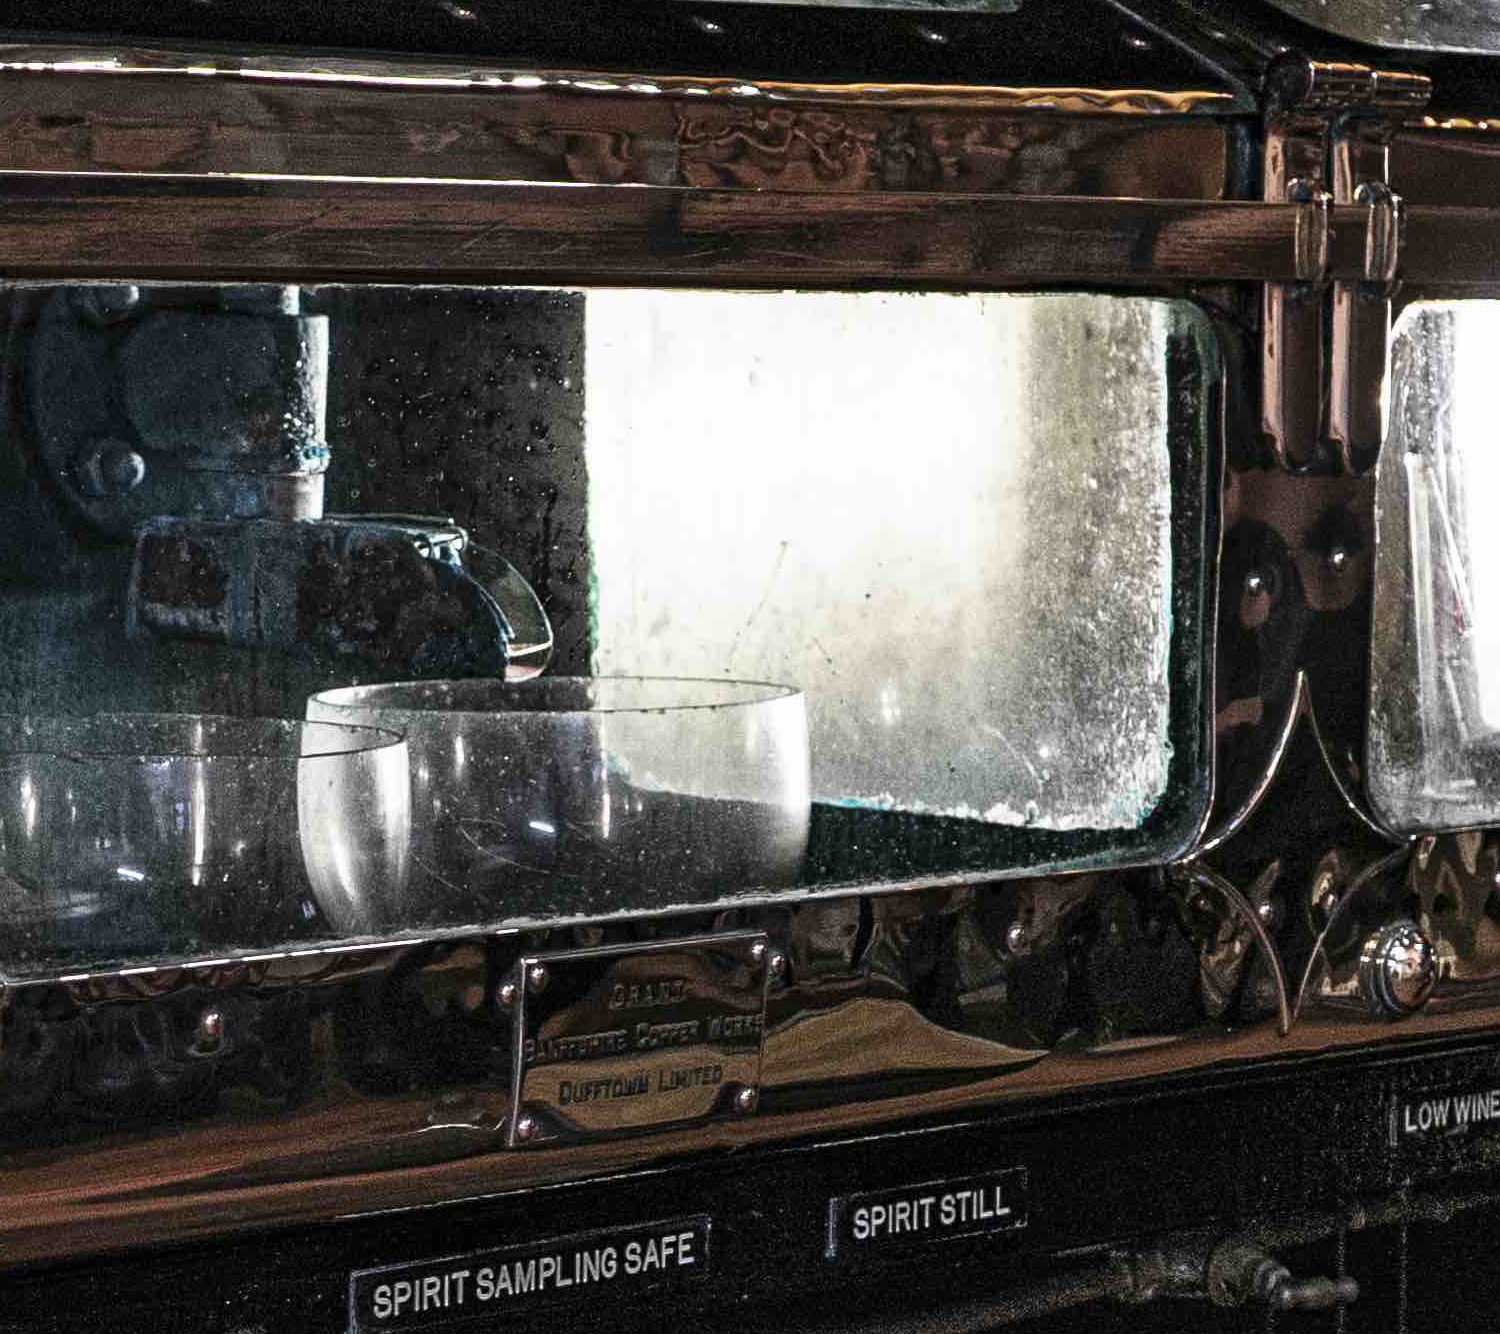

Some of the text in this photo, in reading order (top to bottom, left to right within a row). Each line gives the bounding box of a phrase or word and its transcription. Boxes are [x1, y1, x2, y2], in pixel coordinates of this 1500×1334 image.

[1404, 1096, 1451, 1133] LOW
[852, 1186, 1011, 1239] SPIRIT STILL
[373, 1231, 696, 1318] SPIRIT SAMPLING SAFE
